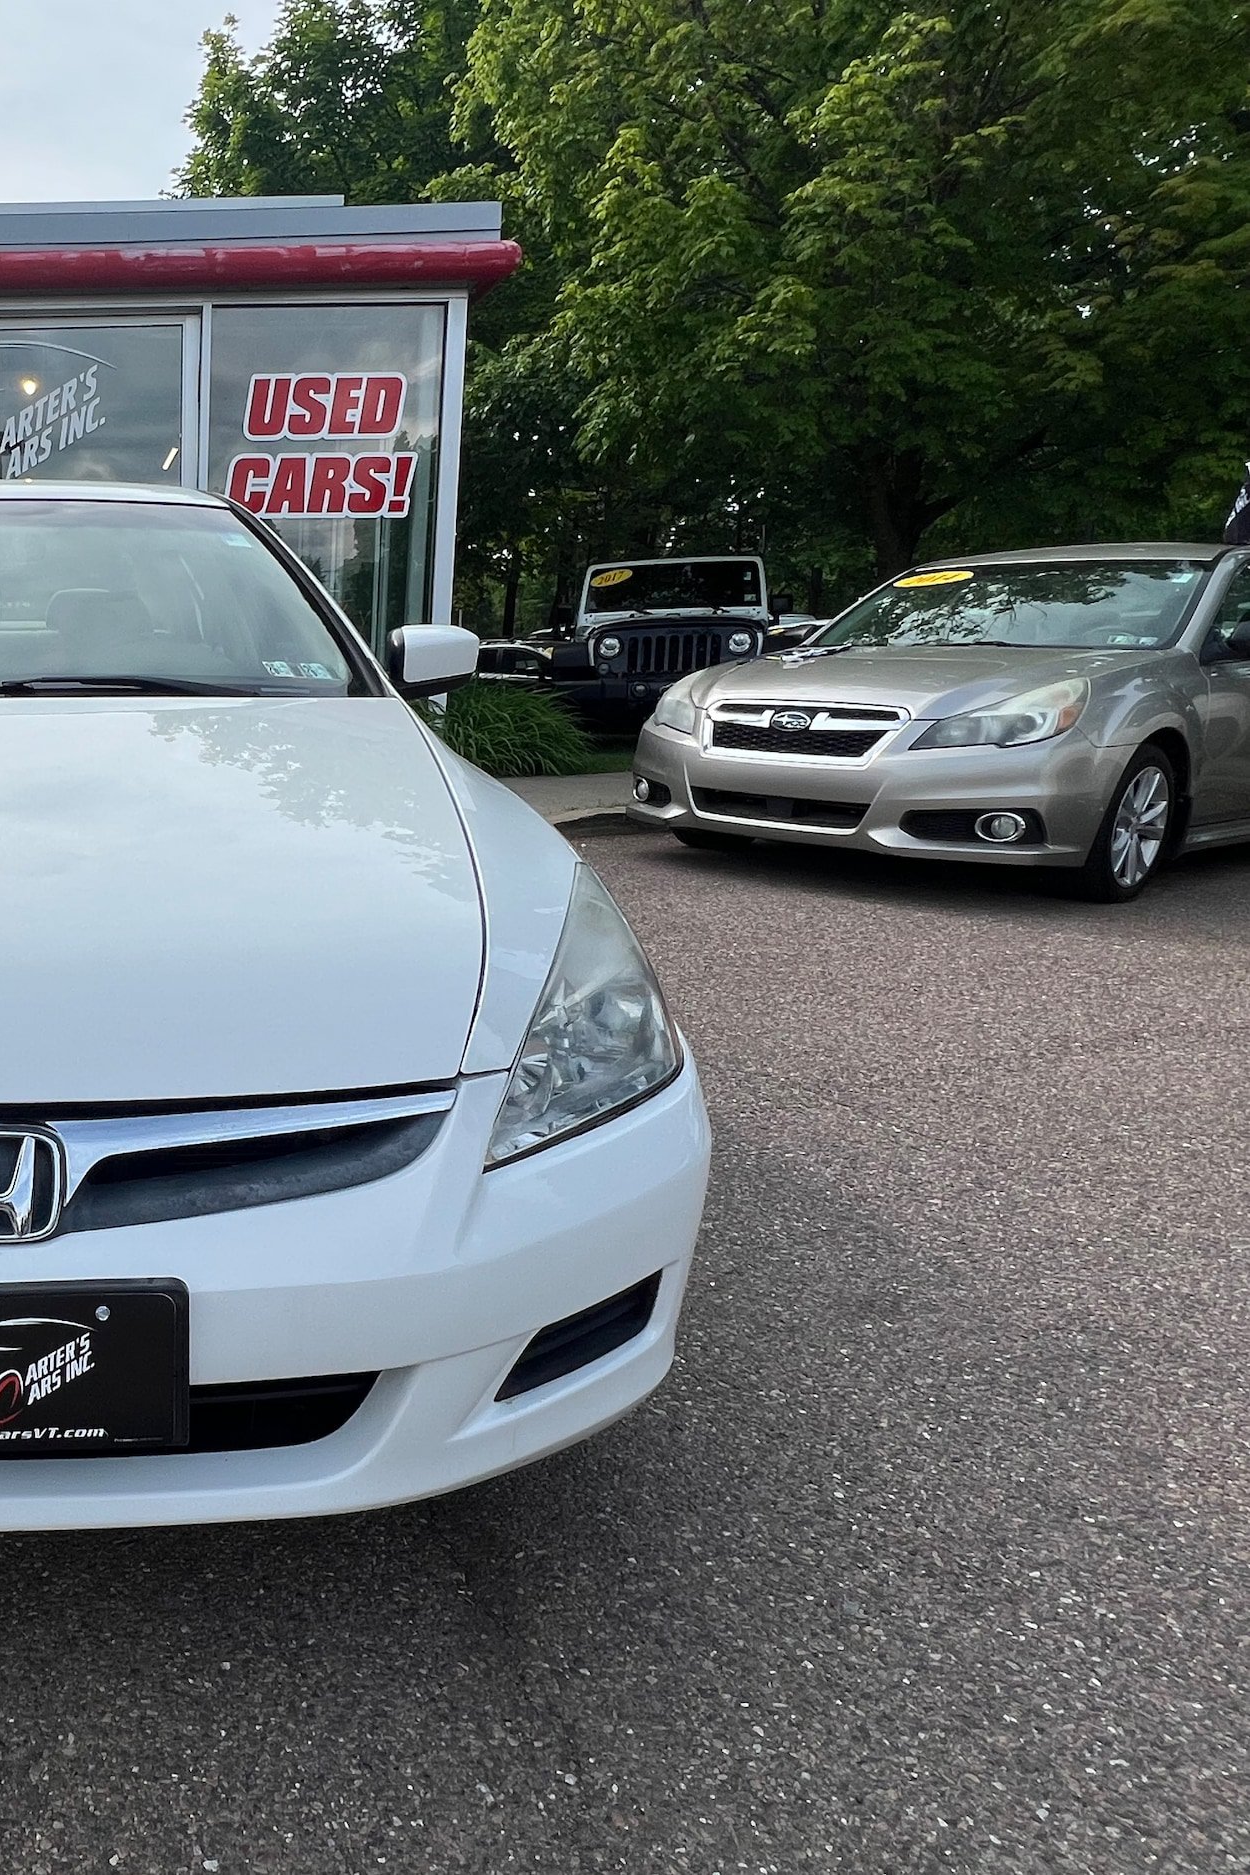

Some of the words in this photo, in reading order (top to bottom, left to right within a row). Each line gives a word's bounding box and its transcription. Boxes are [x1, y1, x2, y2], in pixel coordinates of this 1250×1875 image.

[58, 396, 106, 451] INC.
[247, 375, 405, 438] USED
[228, 454, 414, 515] CARS!
[597, 571, 625, 586] 2017
[66, 1350, 96, 1383] INC.
